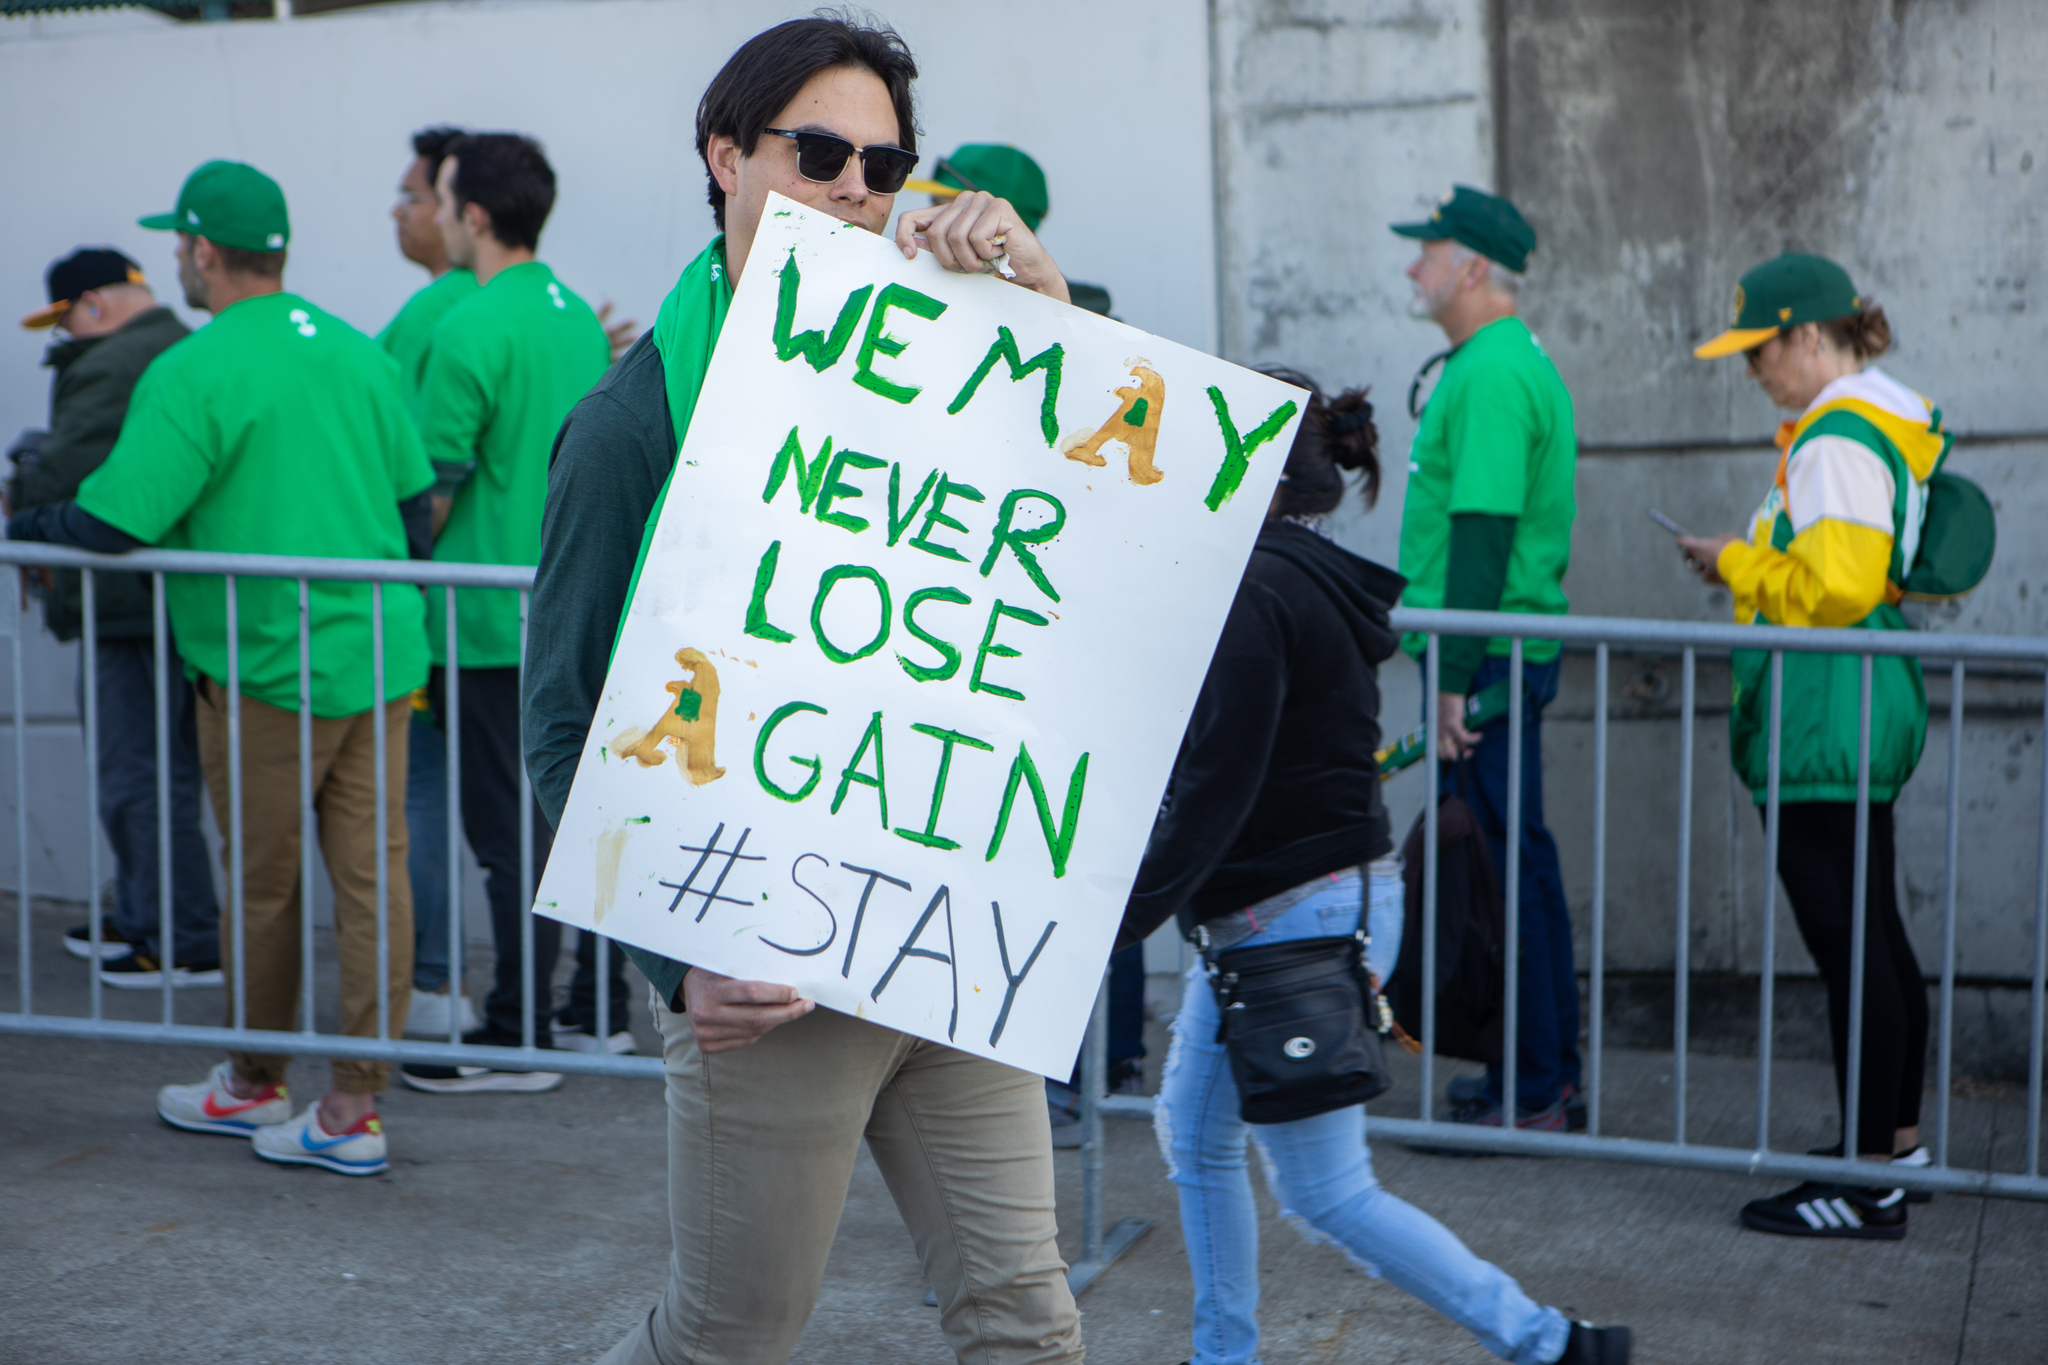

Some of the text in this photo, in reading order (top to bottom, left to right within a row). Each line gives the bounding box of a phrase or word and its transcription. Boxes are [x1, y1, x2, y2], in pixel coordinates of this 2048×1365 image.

[773, 247, 1298, 513] WE MAY
[744, 539, 1049, 702] LOSE
[762, 425, 1067, 604] NEVER
[614, 647, 1090, 879] AGAIN
[658, 822, 1058, 1048] #STAY
